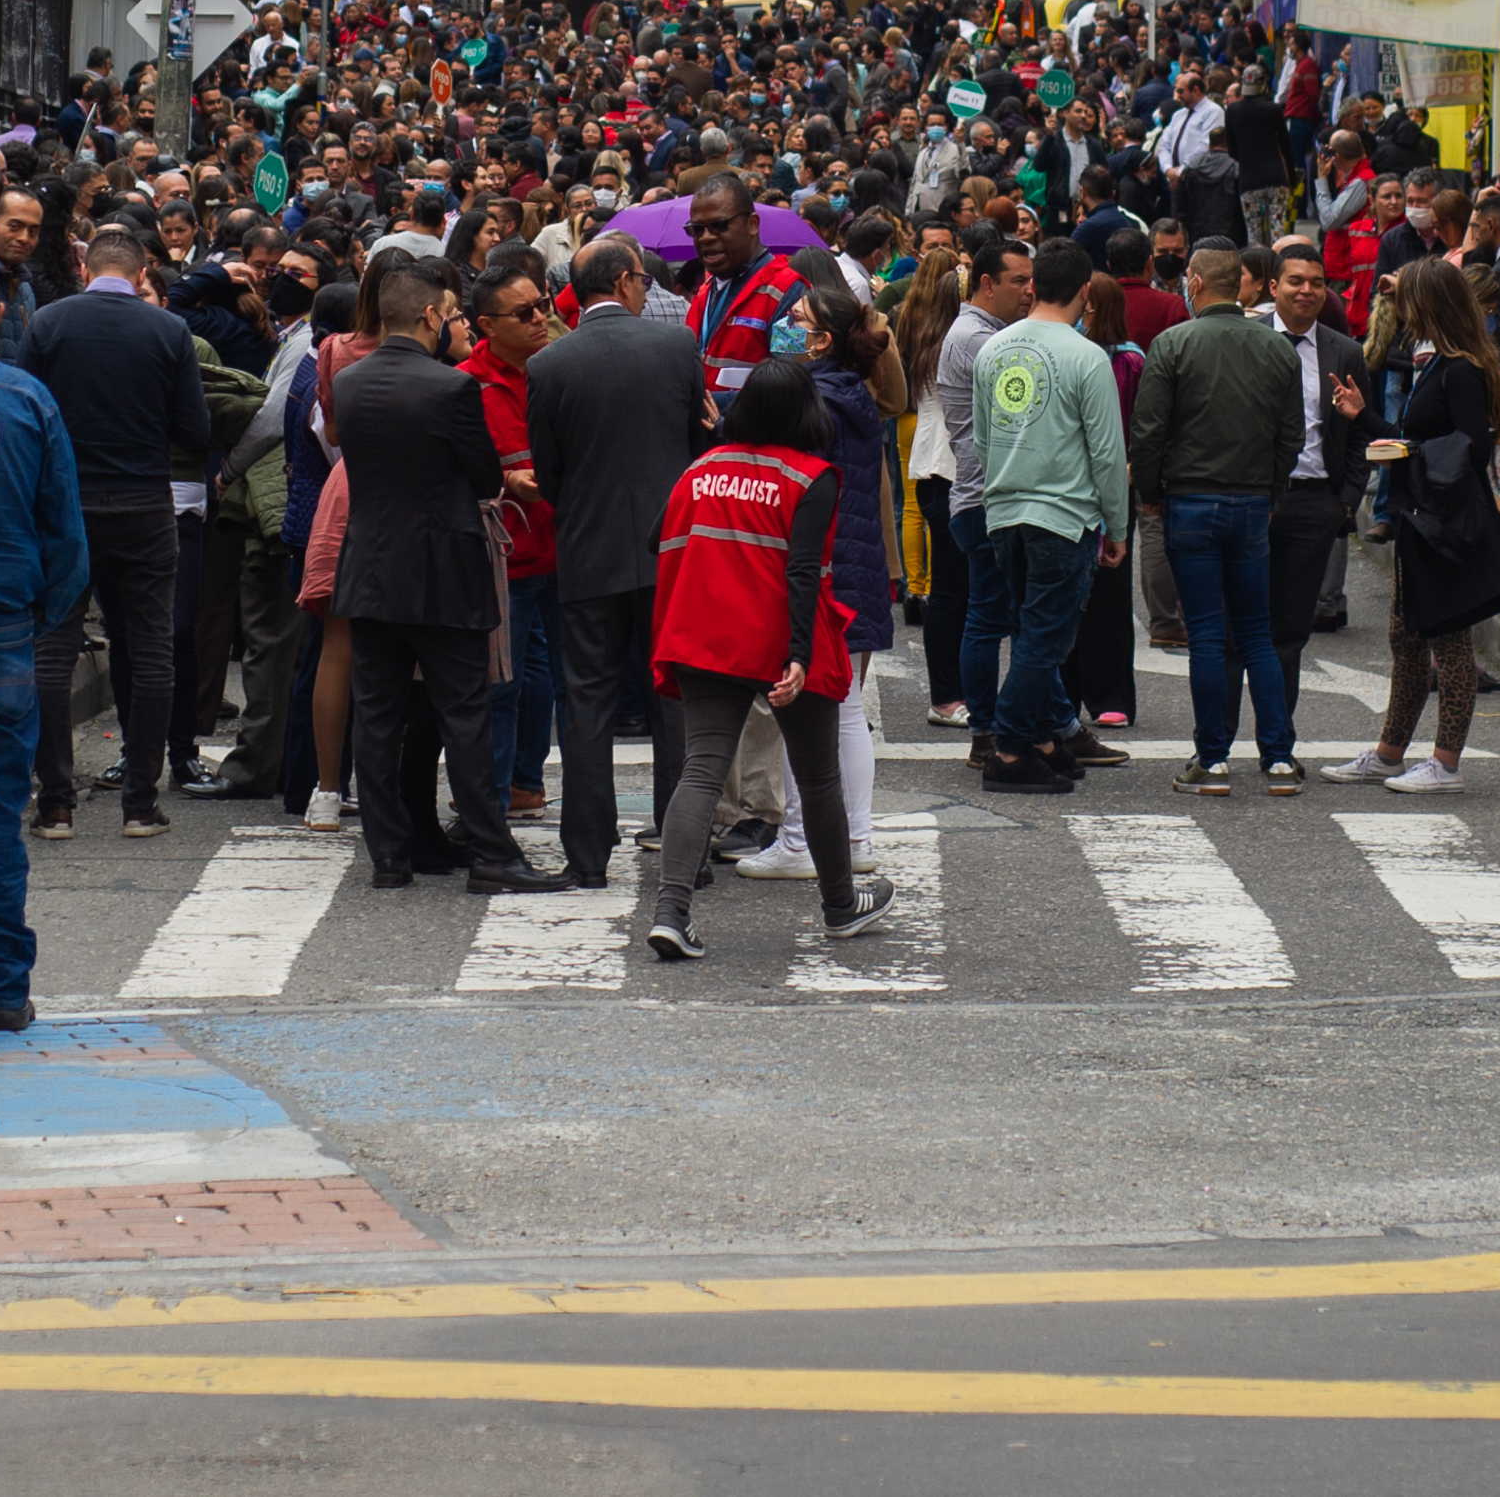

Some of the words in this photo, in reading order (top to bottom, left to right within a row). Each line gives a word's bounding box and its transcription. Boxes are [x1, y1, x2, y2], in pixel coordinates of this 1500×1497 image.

[1040, 80, 1060, 95] PISO
[1062, 84, 1073, 96] 11
[953, 92, 969, 103] Piso
[971, 97, 979, 106] 11
[258, 169, 276, 195] PISO
[276, 177, 283, 198] 5
